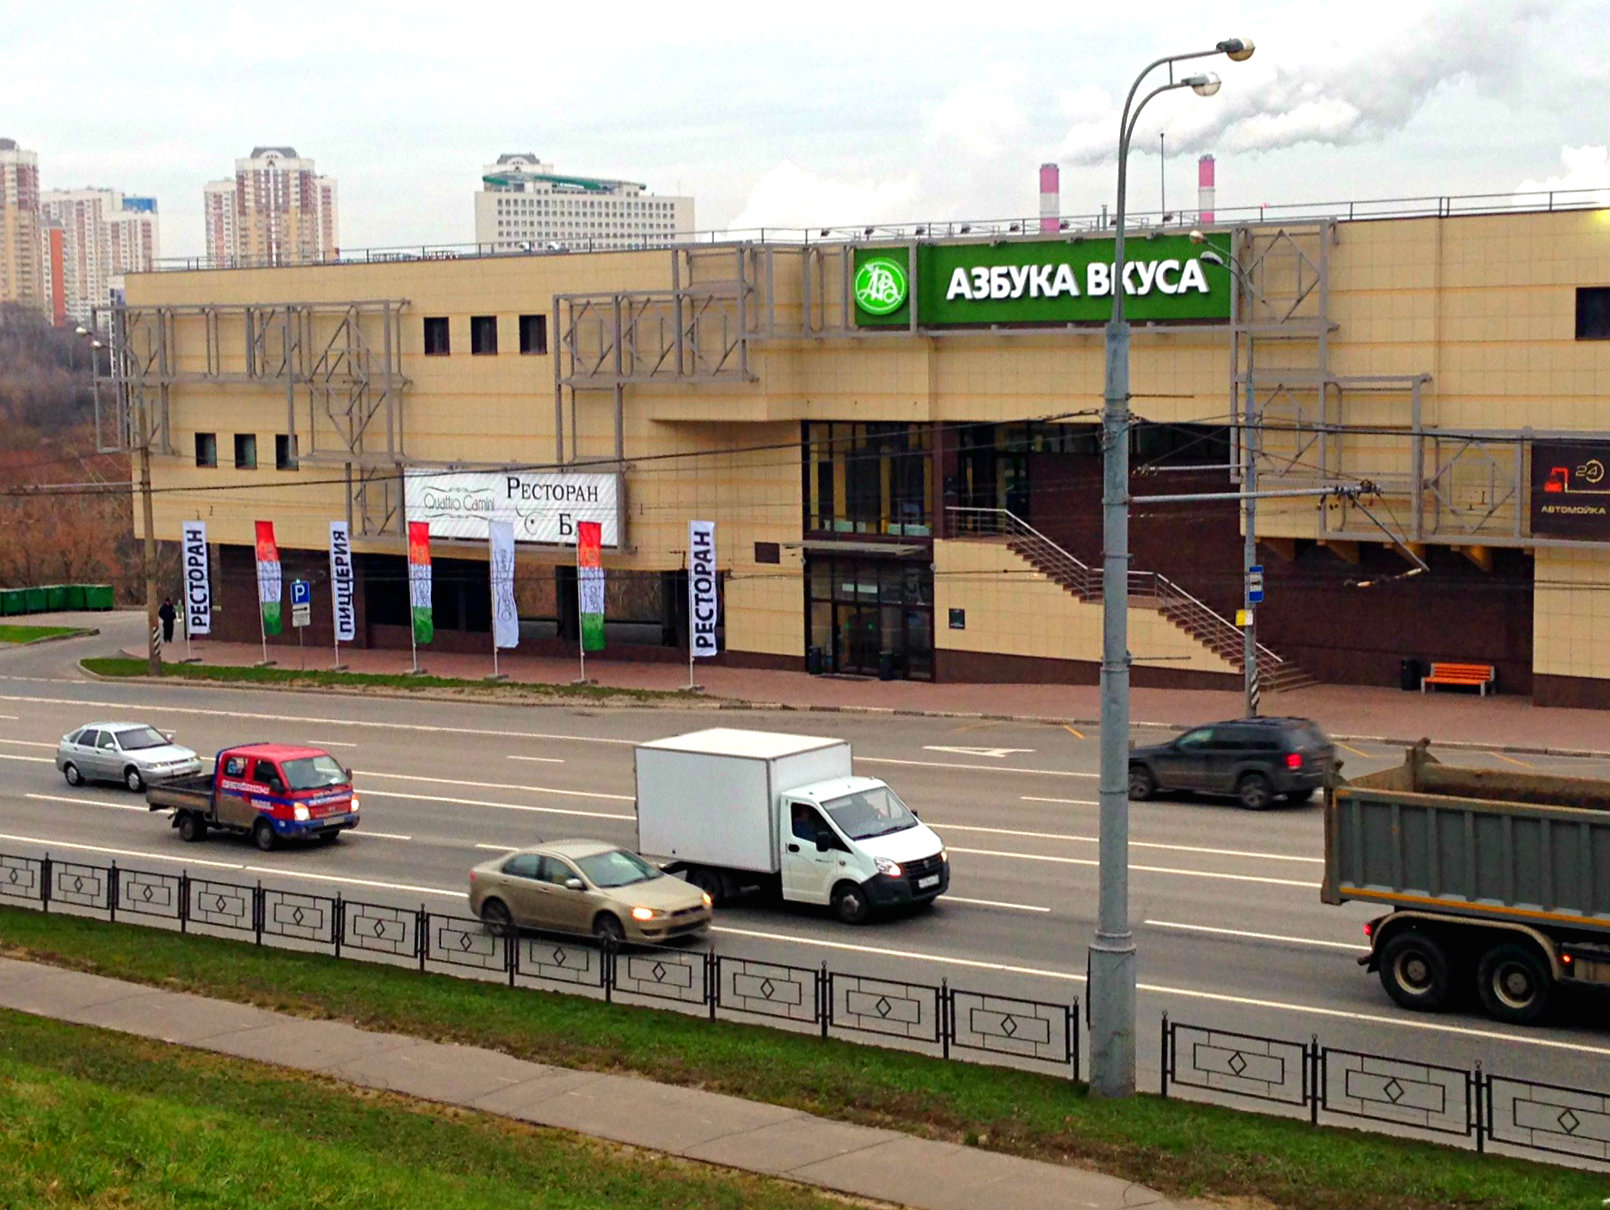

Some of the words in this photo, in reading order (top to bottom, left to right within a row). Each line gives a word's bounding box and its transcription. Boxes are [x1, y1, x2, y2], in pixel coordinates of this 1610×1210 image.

[946, 264, 1080, 299] АЗБУКА
[1087, 258, 1210, 296] ВКУСА
[1541, 504, 1607, 515] АВТОМОЙКА
[186, 529, 208, 628] РЕСТОРАН
[294, 584, 305, 603] P
[332, 530, 354, 633] ПИЦЦЕРИЯ
[693, 531, 714, 649] РЕСТОРАН
